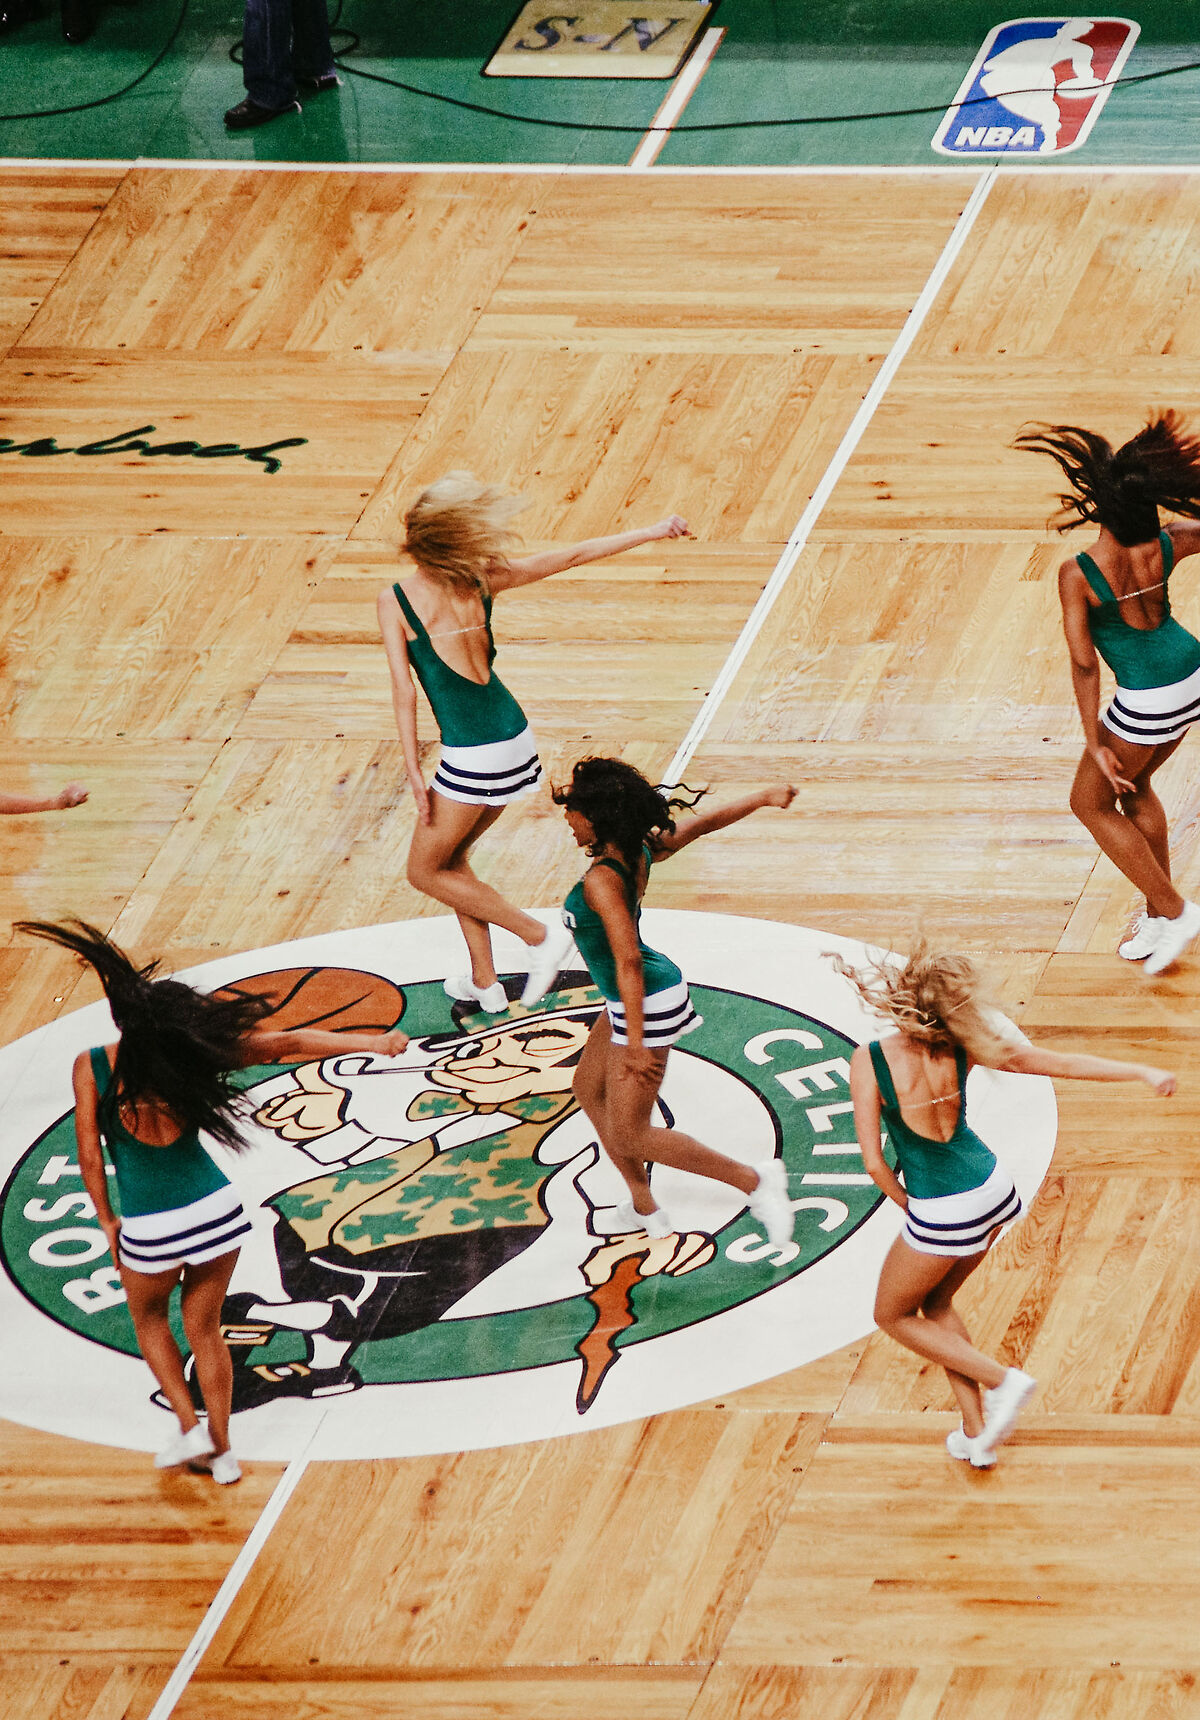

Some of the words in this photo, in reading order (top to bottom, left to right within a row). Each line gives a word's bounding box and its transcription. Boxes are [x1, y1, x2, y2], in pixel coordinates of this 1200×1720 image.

[513, 15, 686, 51] S-N
[954, 126, 1036, 147] NBA
[23, 1155, 128, 1315] BOST
